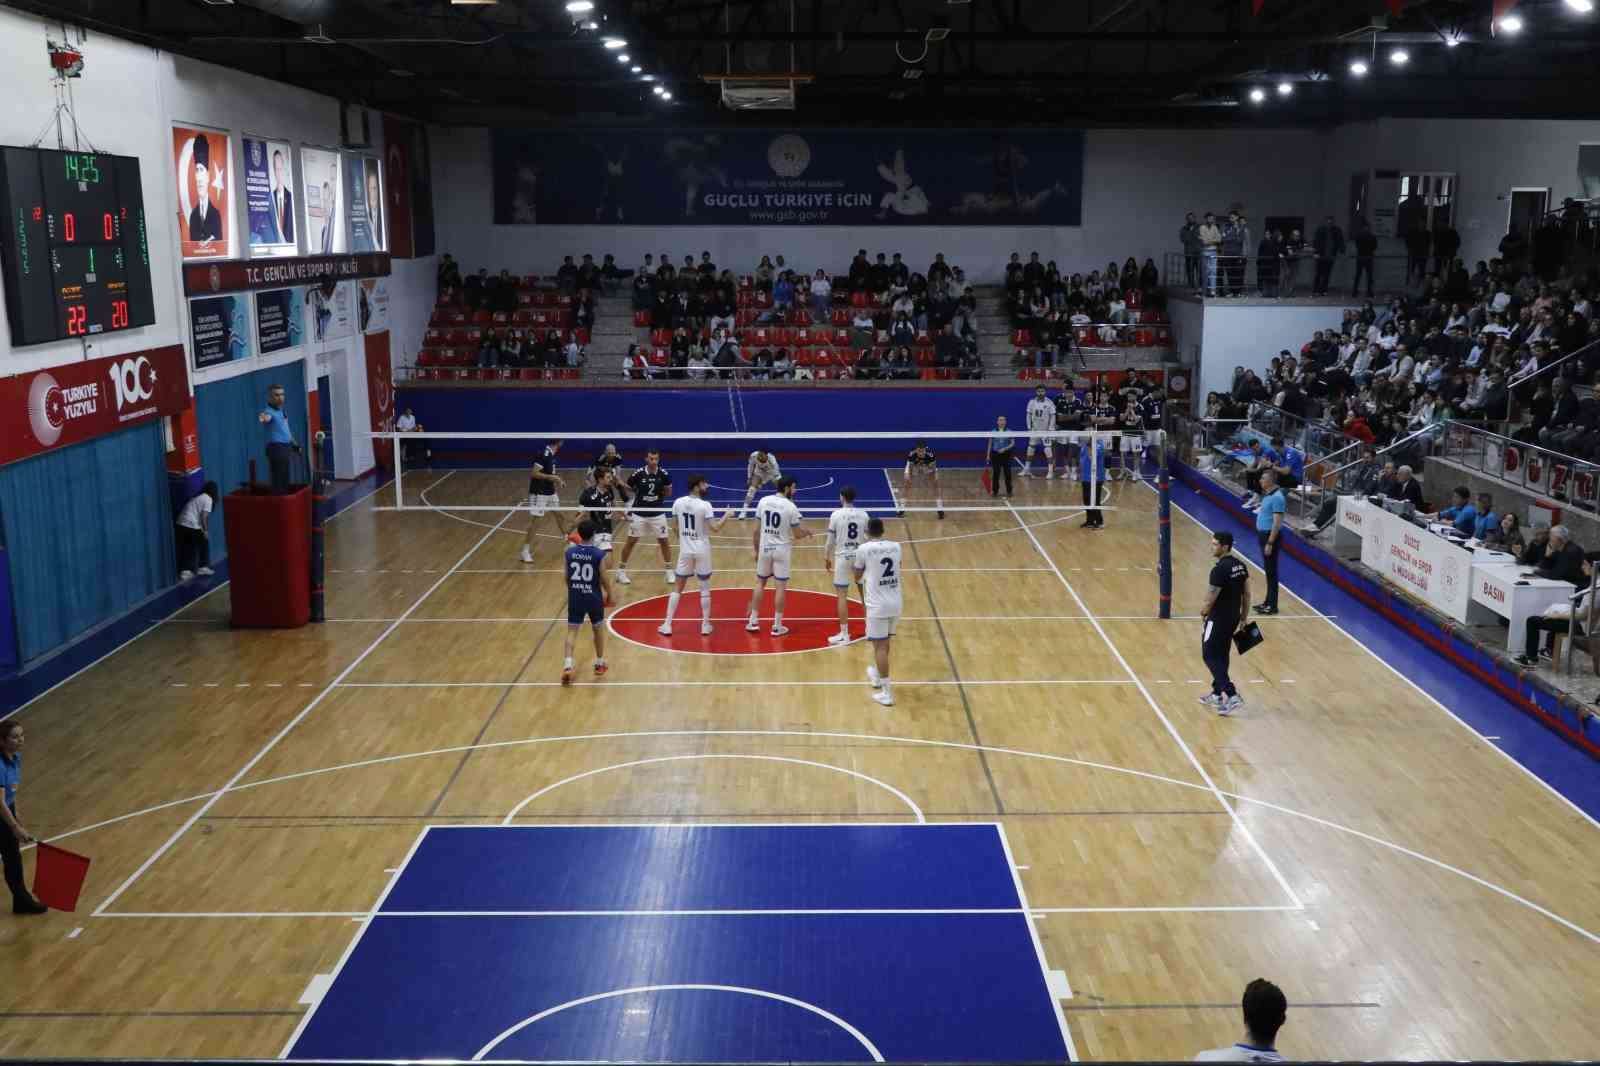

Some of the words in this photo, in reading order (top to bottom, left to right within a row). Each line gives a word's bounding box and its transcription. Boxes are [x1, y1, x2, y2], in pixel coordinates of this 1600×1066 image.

[64, 213, 75, 241] 0
[104, 213, 113, 240] 0
[68, 305, 86, 335] 22
[111, 301, 128, 328] 20
[648, 483, 655, 496] 2
[682, 512, 696, 530] 11
[764, 510, 781, 529] 10
[847, 522, 858, 540] 8
[570, 562, 594, 582] 20
[880, 557, 895, 577] 2
[1483, 581, 1505, 604] BASIN
